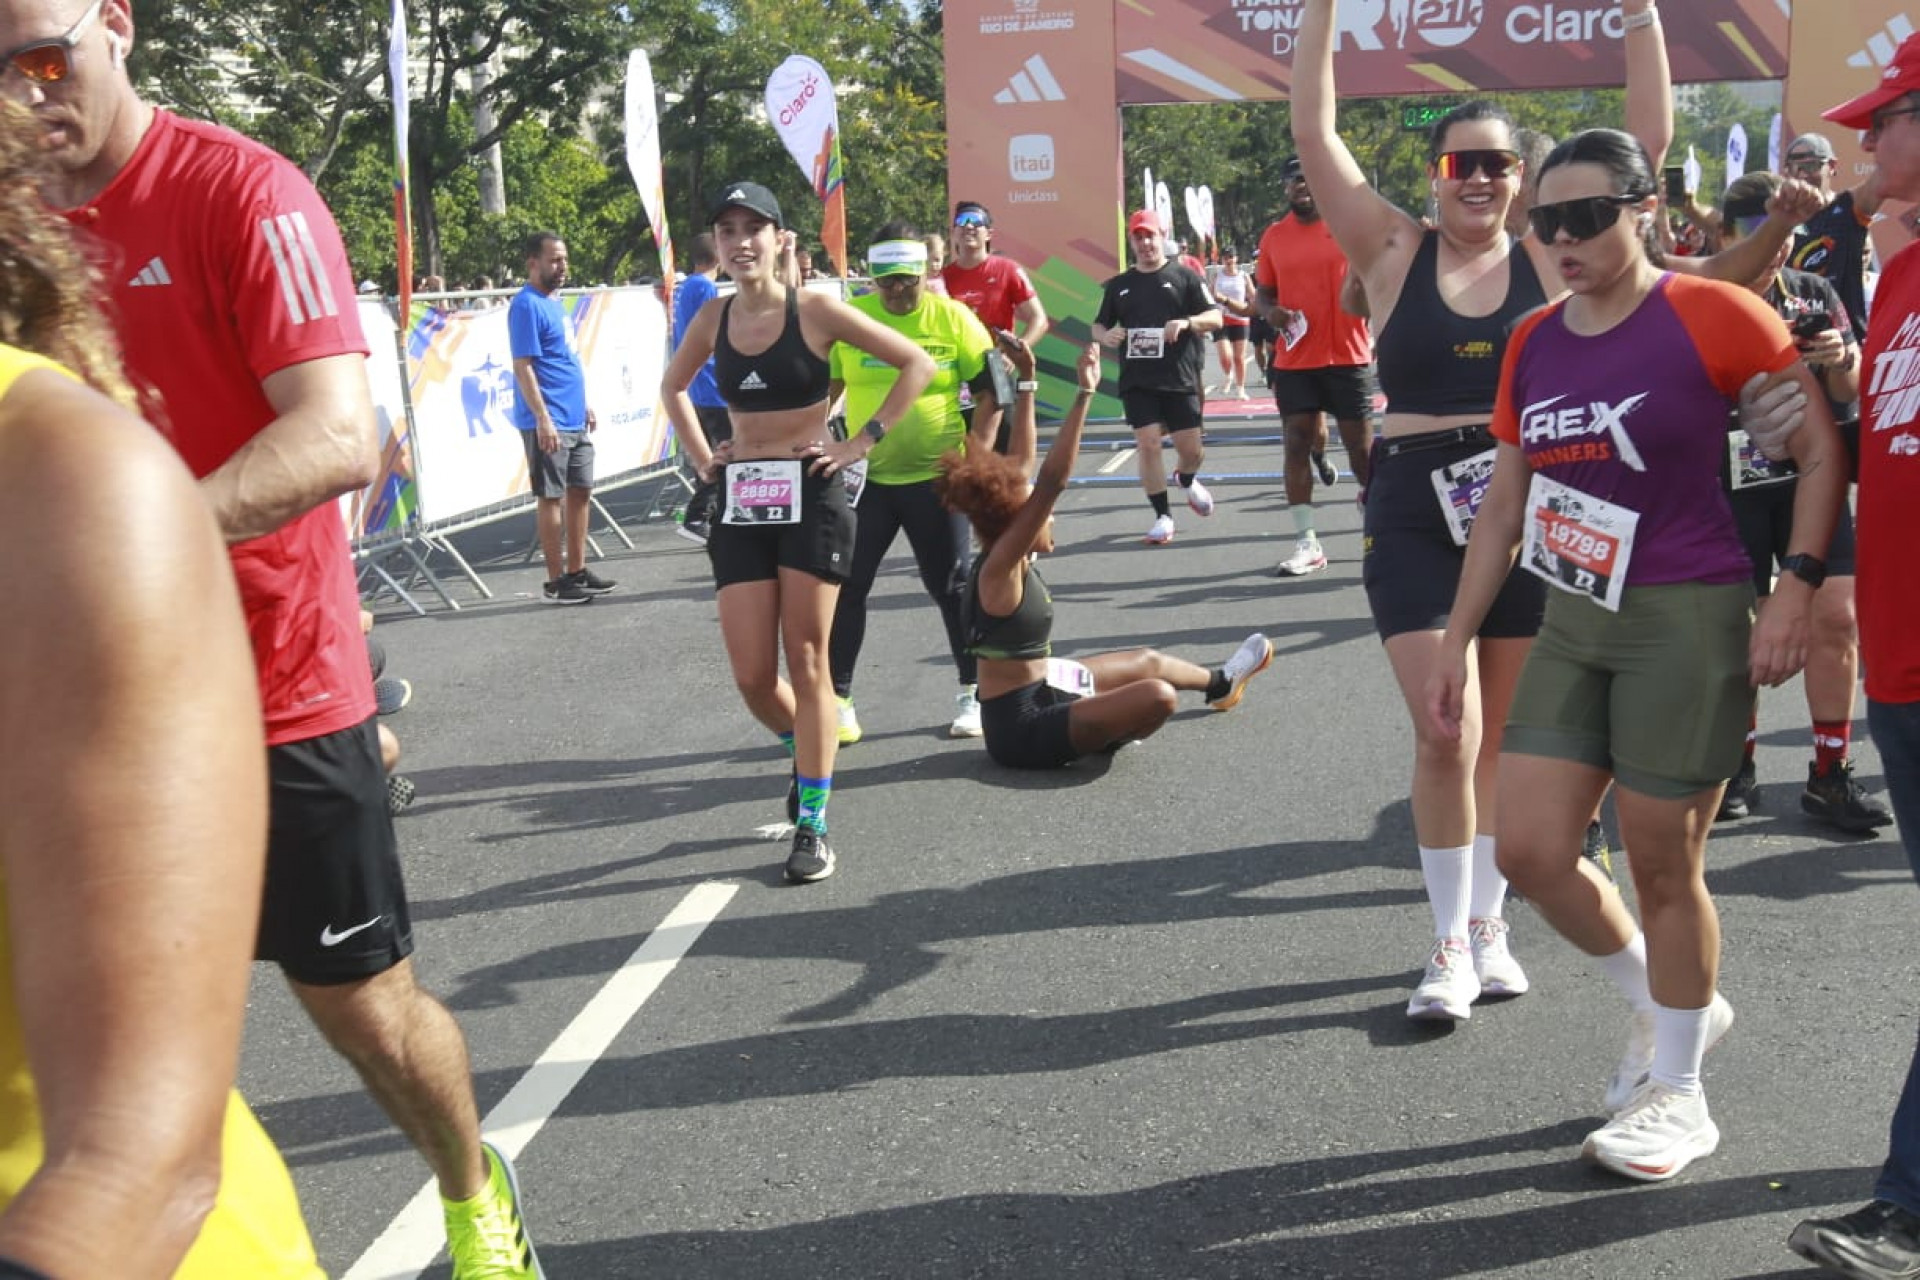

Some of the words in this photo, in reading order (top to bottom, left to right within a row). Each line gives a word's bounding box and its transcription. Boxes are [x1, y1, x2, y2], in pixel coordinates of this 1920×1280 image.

[779, 84, 816, 126] Claro
[1013, 153, 1050, 172] itaú
[1009, 189, 1059, 203] Uniclass
